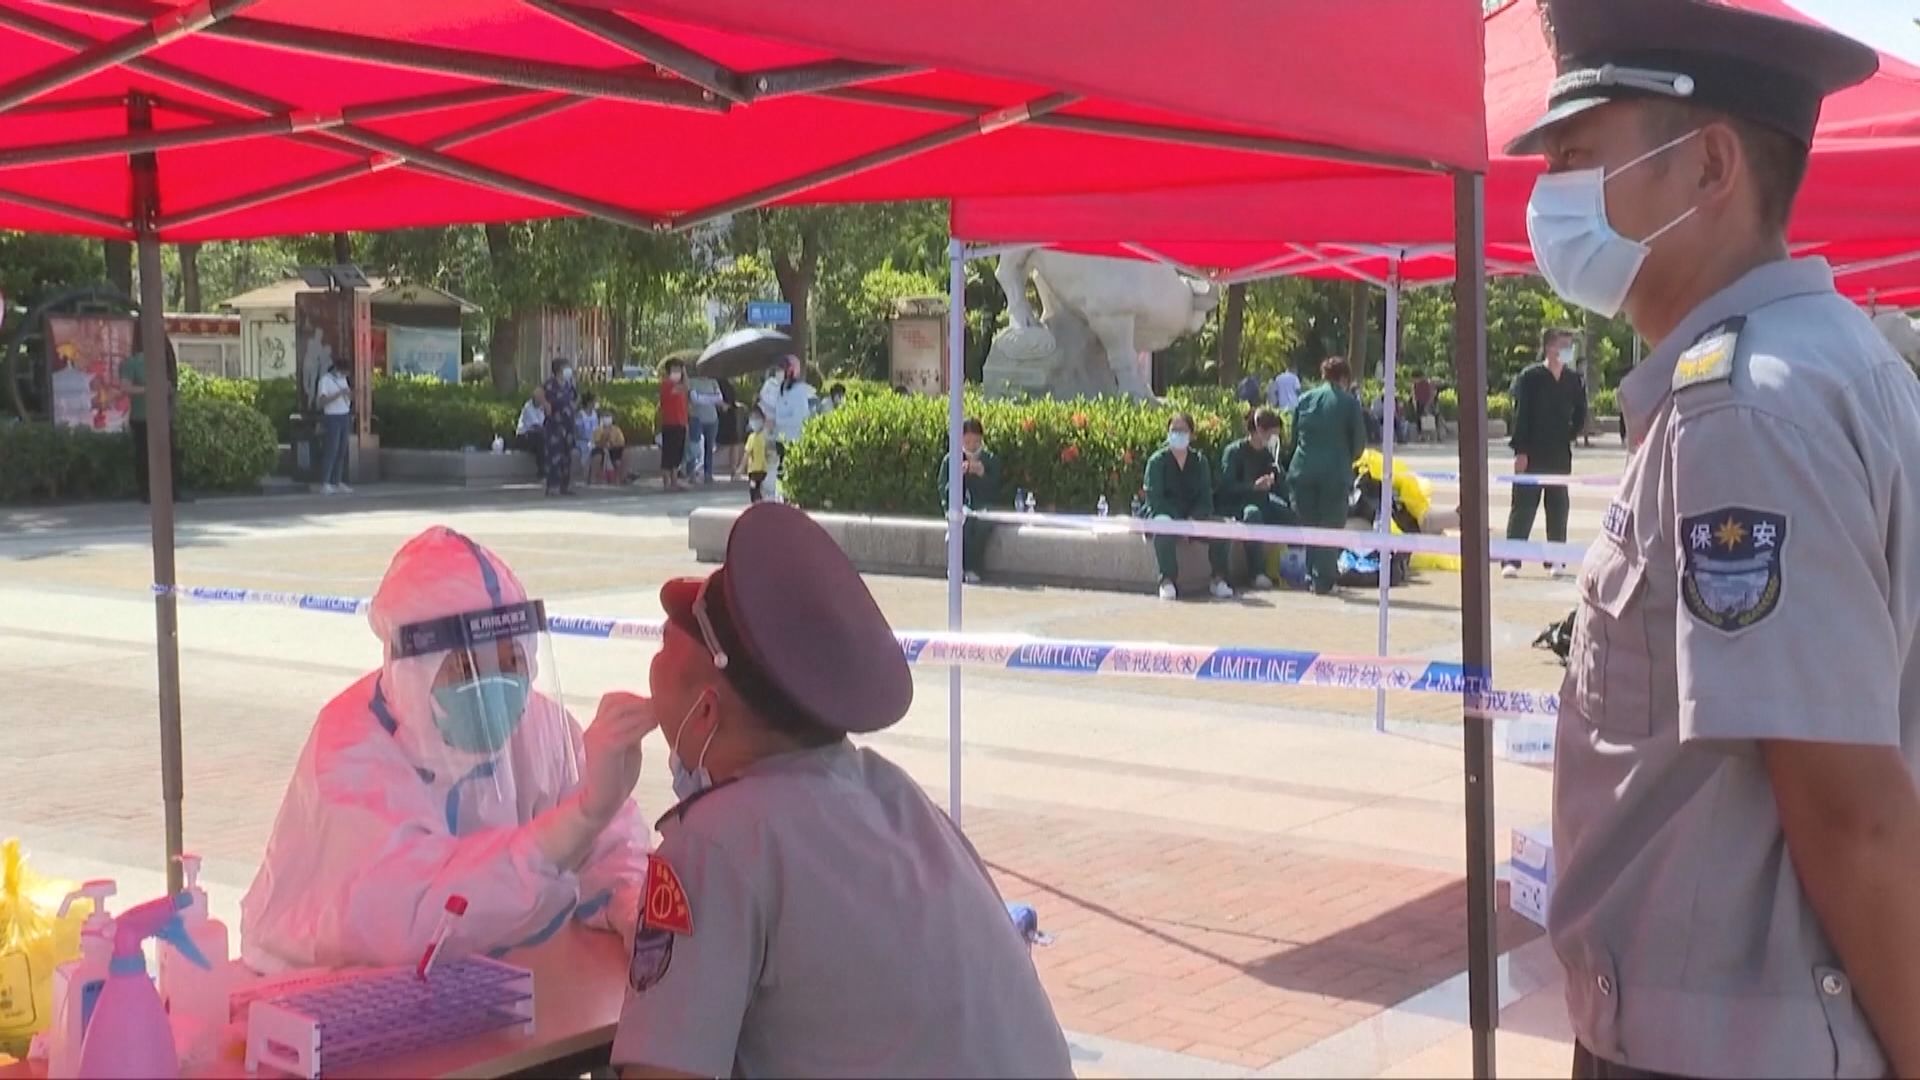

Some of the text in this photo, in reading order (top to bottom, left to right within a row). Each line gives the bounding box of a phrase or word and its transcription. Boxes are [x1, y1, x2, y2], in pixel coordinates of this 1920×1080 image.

[1690, 520, 1777, 549] 保 安
[1019, 643, 1098, 669] LIMITLINE
[1113, 648, 1172, 674] 警戒线
[1209, 655, 1298, 683] LIMITLINE
[1315, 660, 1383, 688] 警戒线
